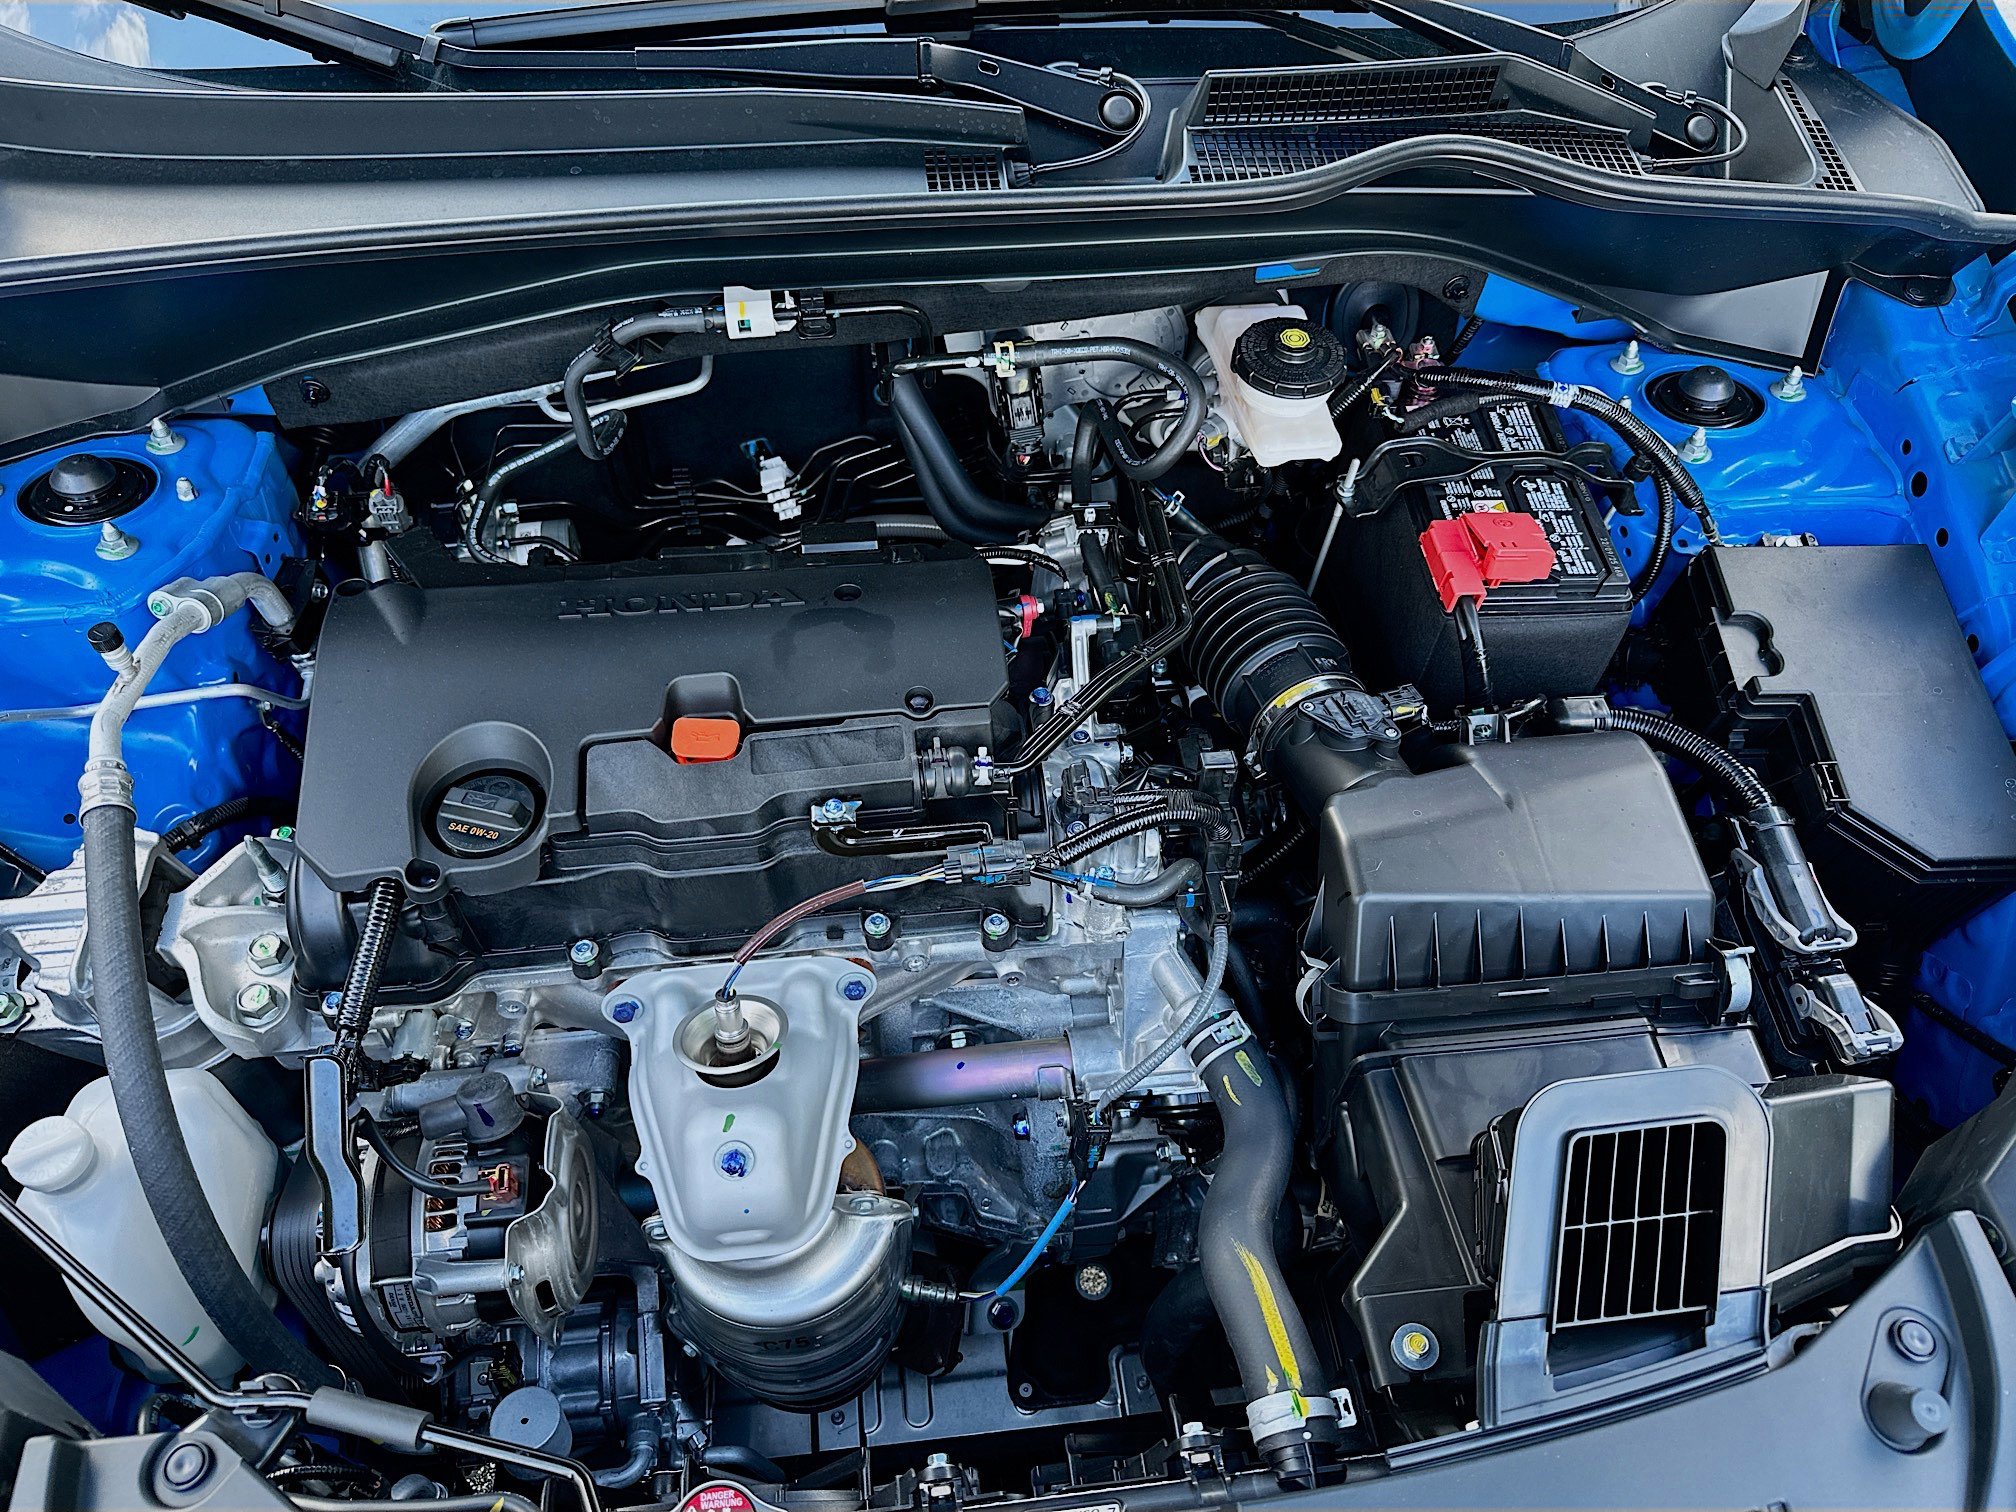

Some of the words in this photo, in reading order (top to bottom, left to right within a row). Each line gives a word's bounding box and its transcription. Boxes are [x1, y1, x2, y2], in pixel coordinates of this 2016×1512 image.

[557, 587, 807, 620] HONDA
[448, 822, 470, 833] SAE
[469, 826, 500, 840] 0W-20
[699, 1490, 735, 1502] DANGER
[700, 1497, 743, 1510] WARNUNG
